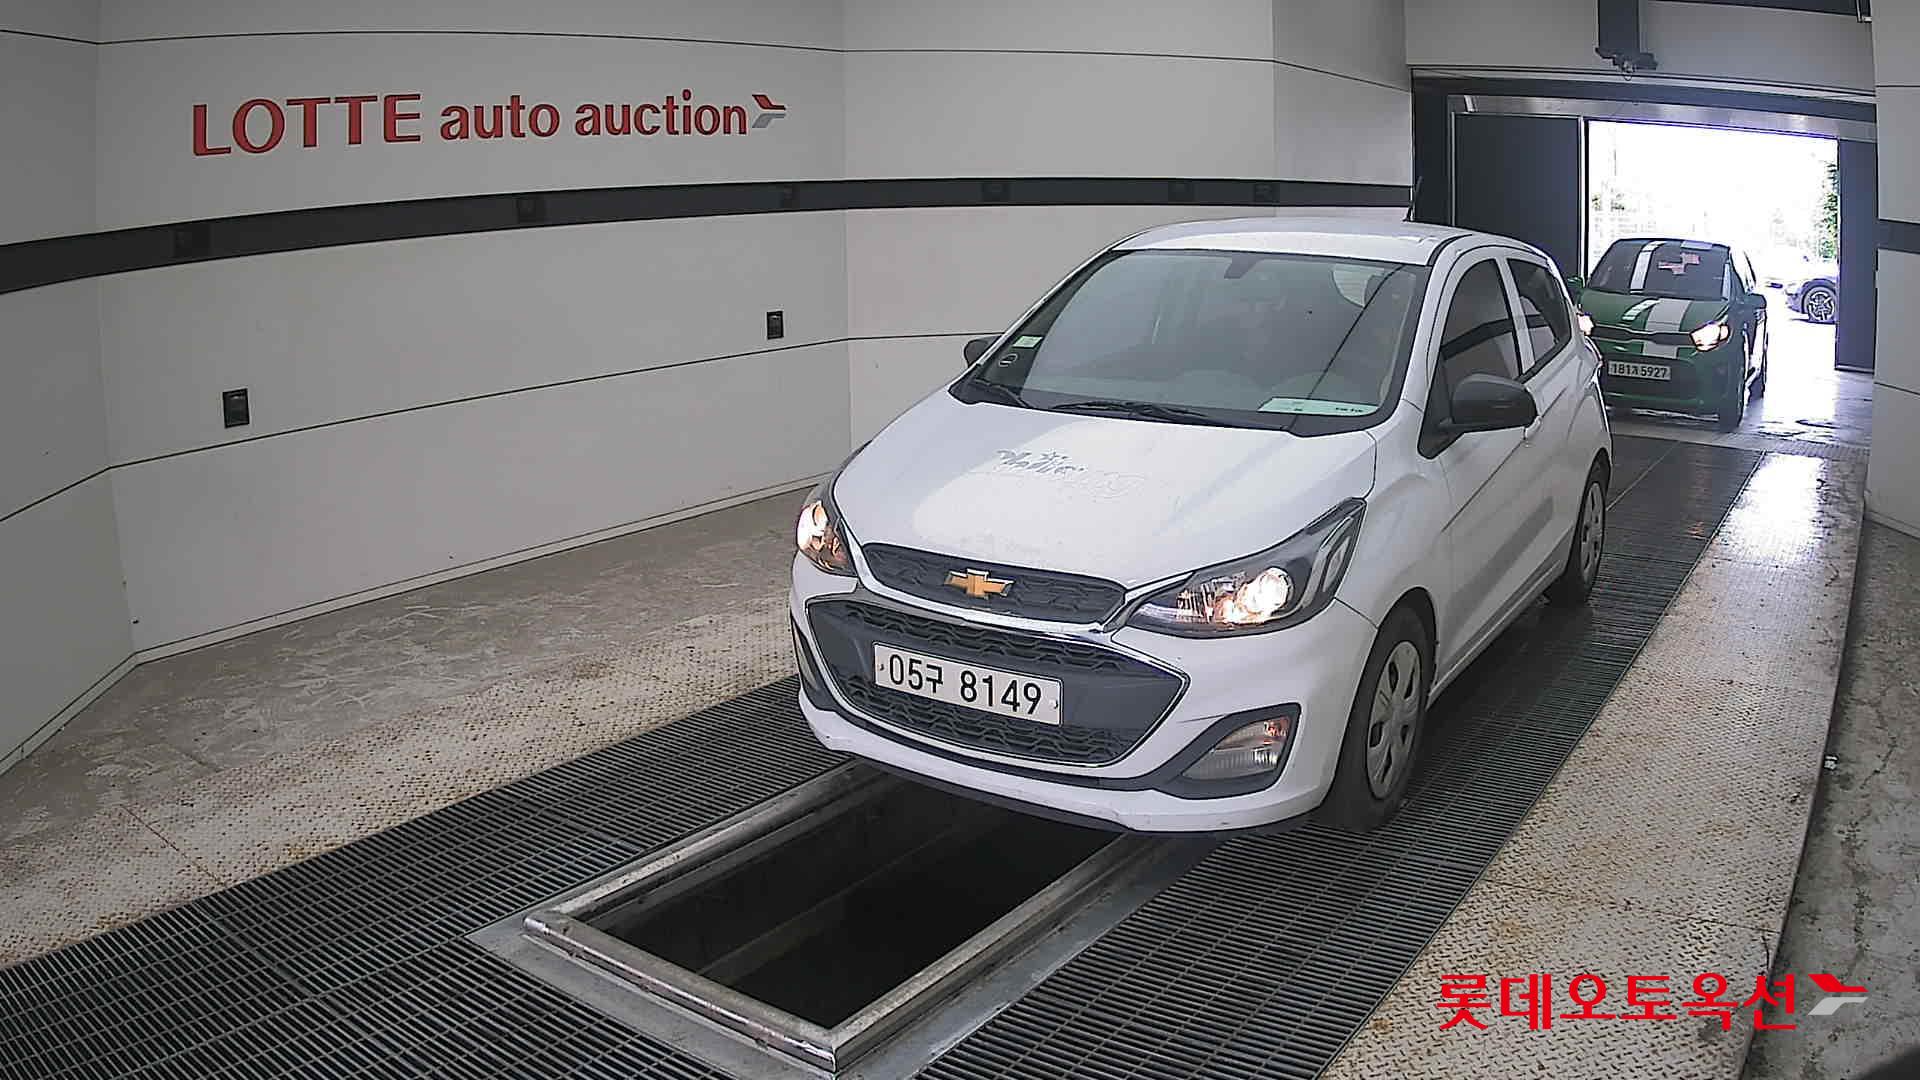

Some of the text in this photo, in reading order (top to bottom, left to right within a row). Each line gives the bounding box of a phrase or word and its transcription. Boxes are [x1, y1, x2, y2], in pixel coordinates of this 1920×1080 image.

[193, 89, 748, 156] LOTTE auto auction
[889, 654, 1041, 714] 05구 8149
